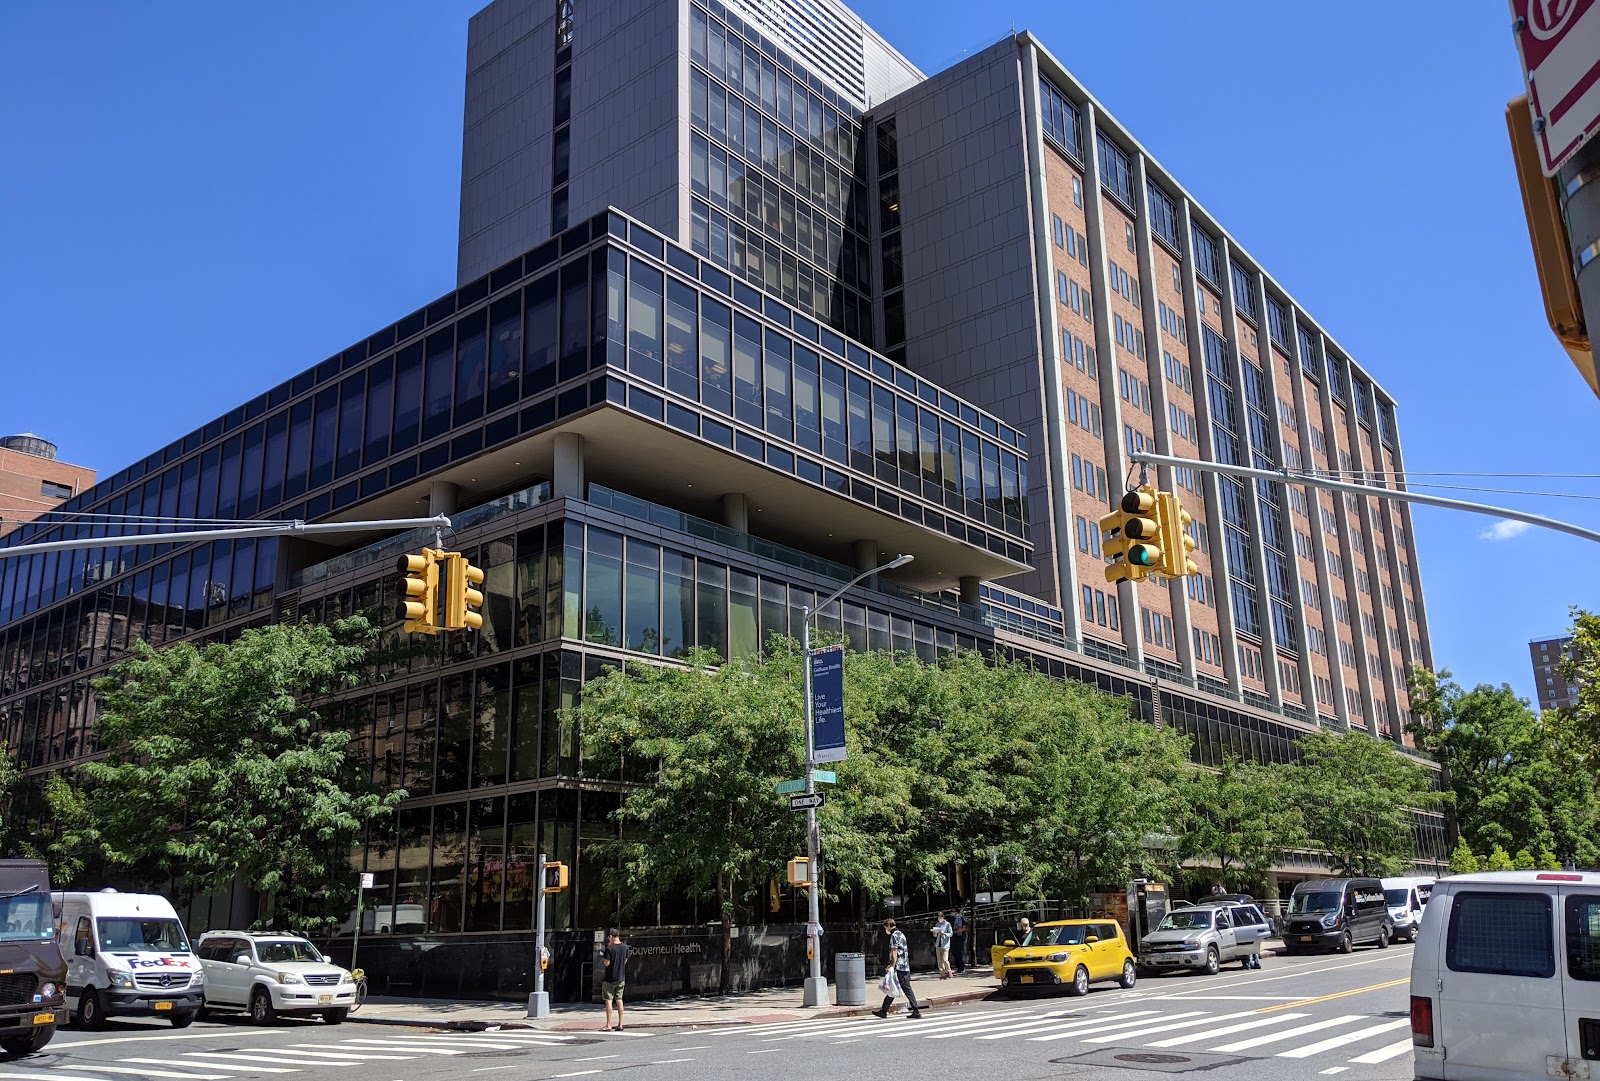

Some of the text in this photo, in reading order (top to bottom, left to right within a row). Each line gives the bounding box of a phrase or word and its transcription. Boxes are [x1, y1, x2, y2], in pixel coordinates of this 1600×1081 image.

[814, 693, 826, 701] Live
[814, 701, 828, 709] Your
[814, 706, 842, 716] Healthiest
[815, 715, 827, 724] Life.
[794, 798, 805, 806] ONE
[127, 957, 192, 969] FedEx
